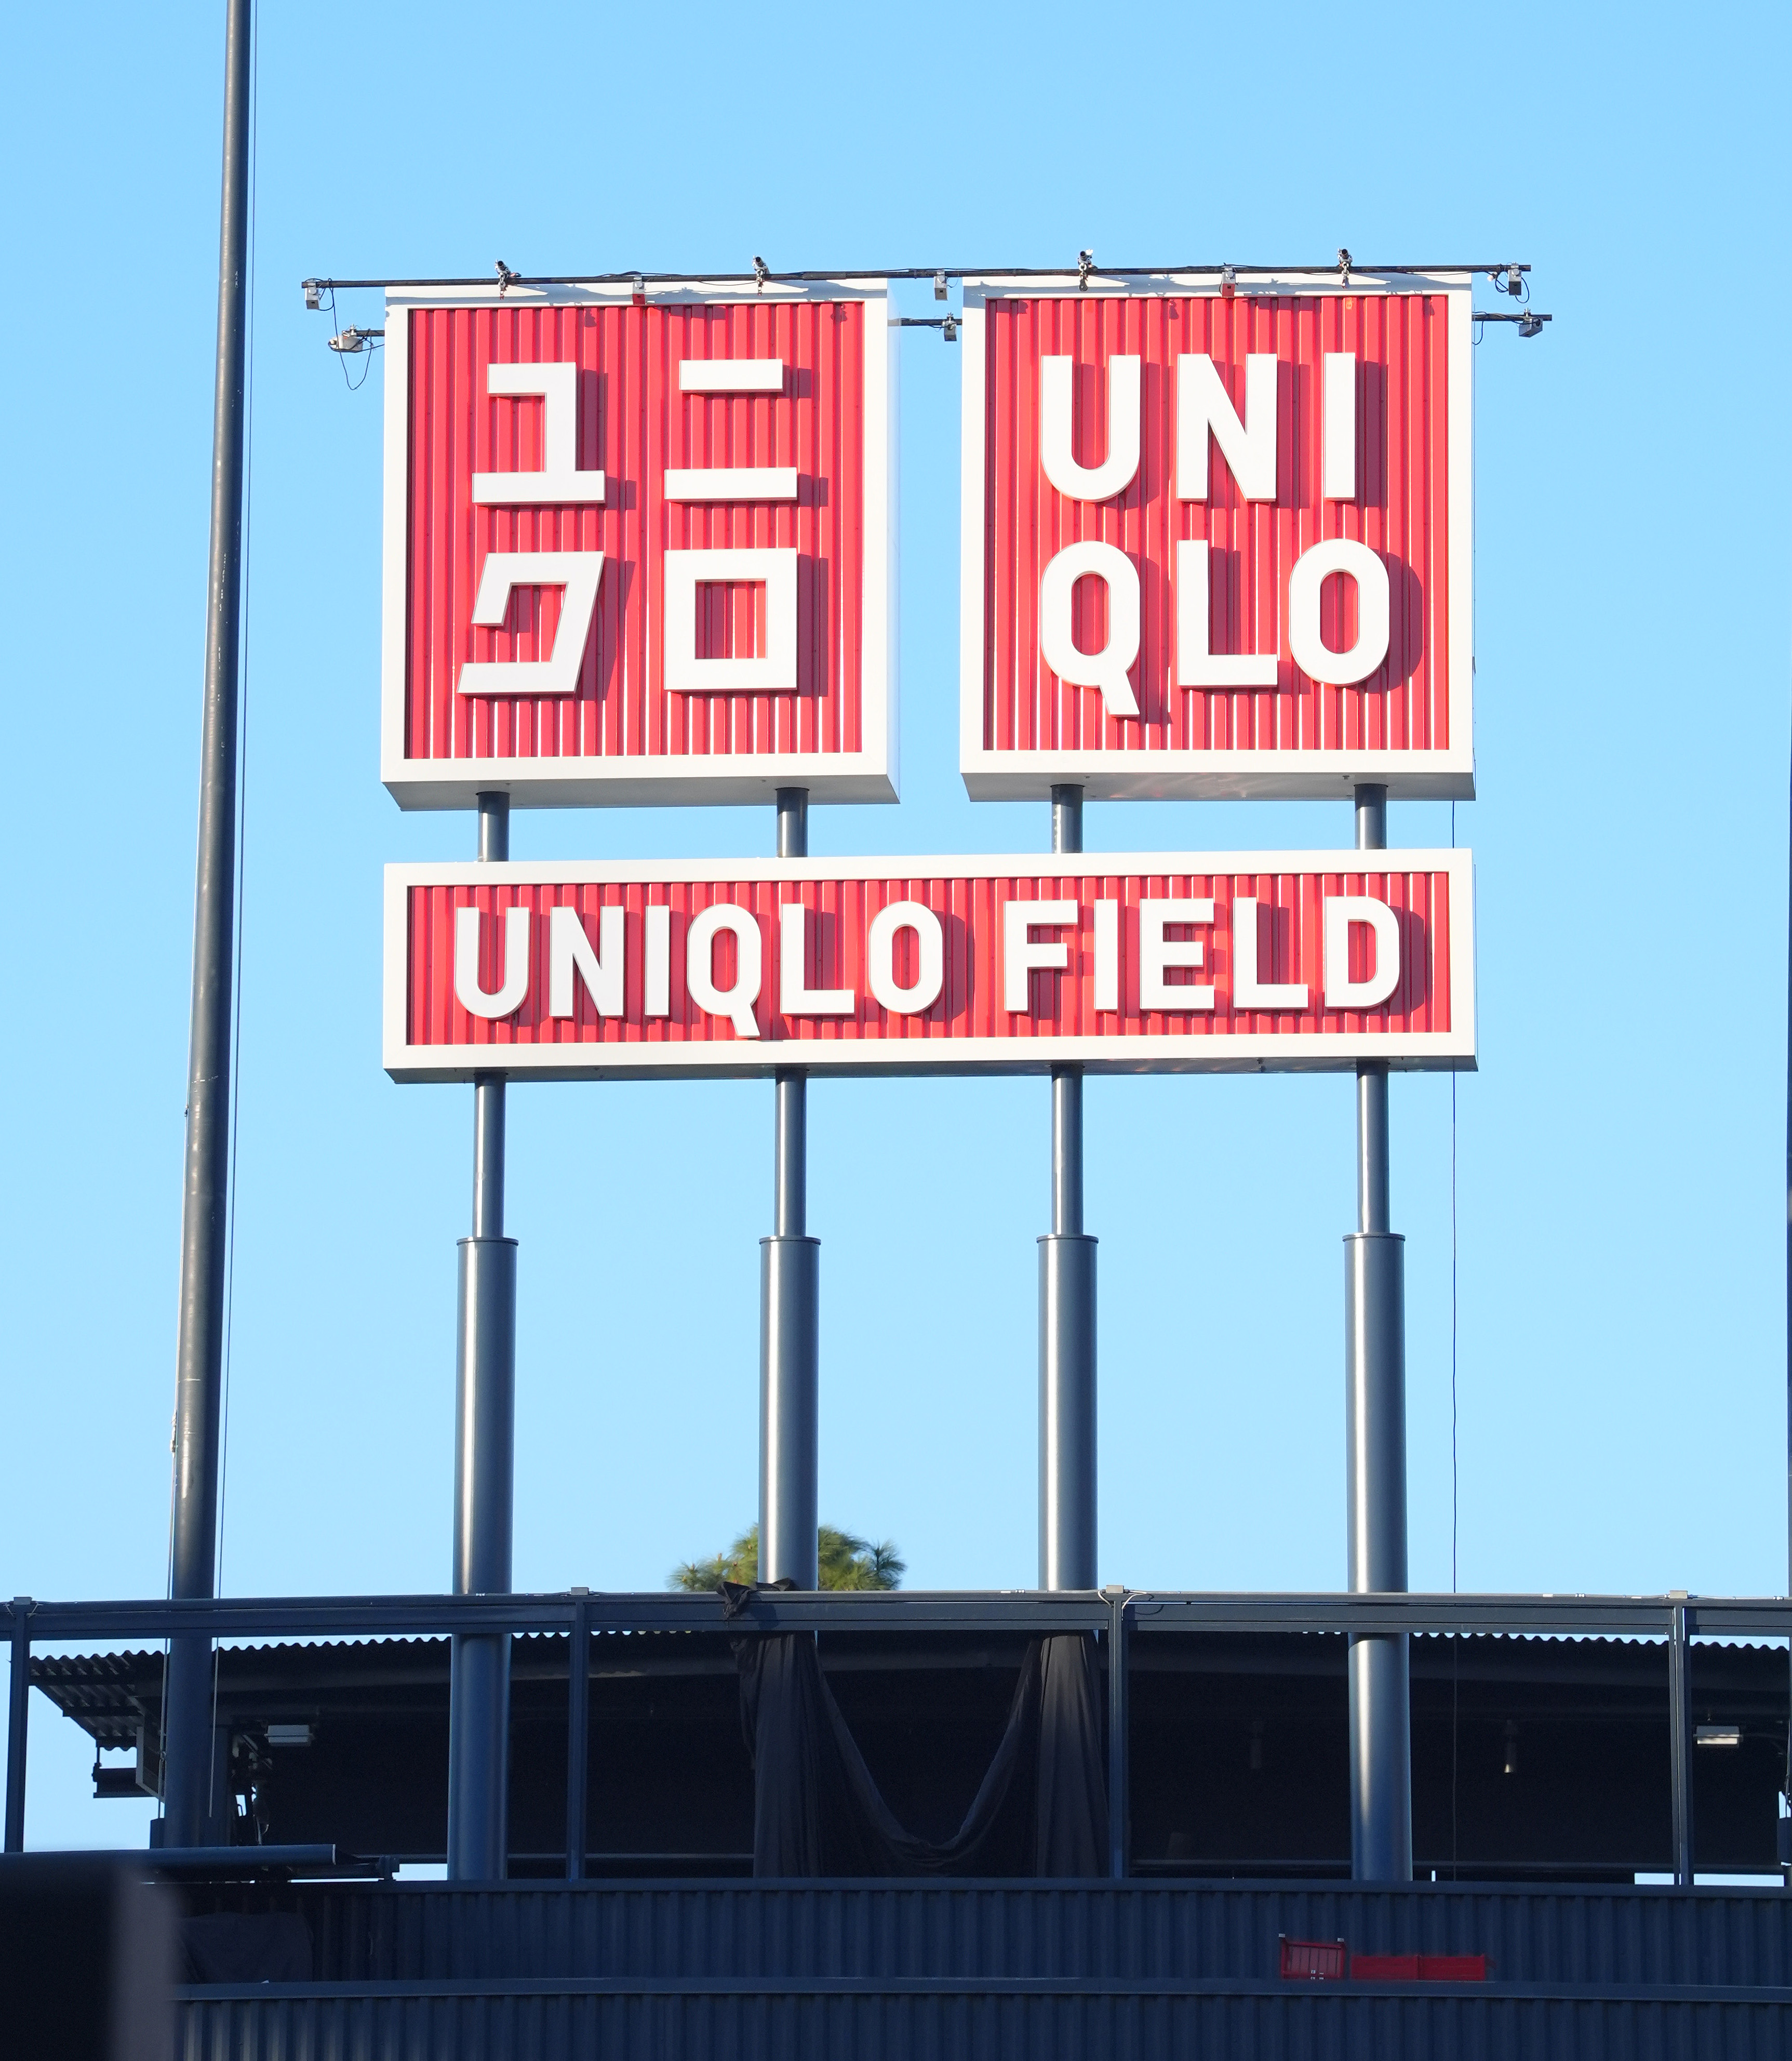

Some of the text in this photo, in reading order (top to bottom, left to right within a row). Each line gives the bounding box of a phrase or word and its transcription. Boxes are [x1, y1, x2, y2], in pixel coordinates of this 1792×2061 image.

[472, 358, 798, 505] ユニ
[1040, 352, 1357, 501] UNI
[458, 549, 798, 694] クロ
[1040, 538, 1390, 718] QLO
[454, 895, 1401, 1037] UNIQLO FIELD
